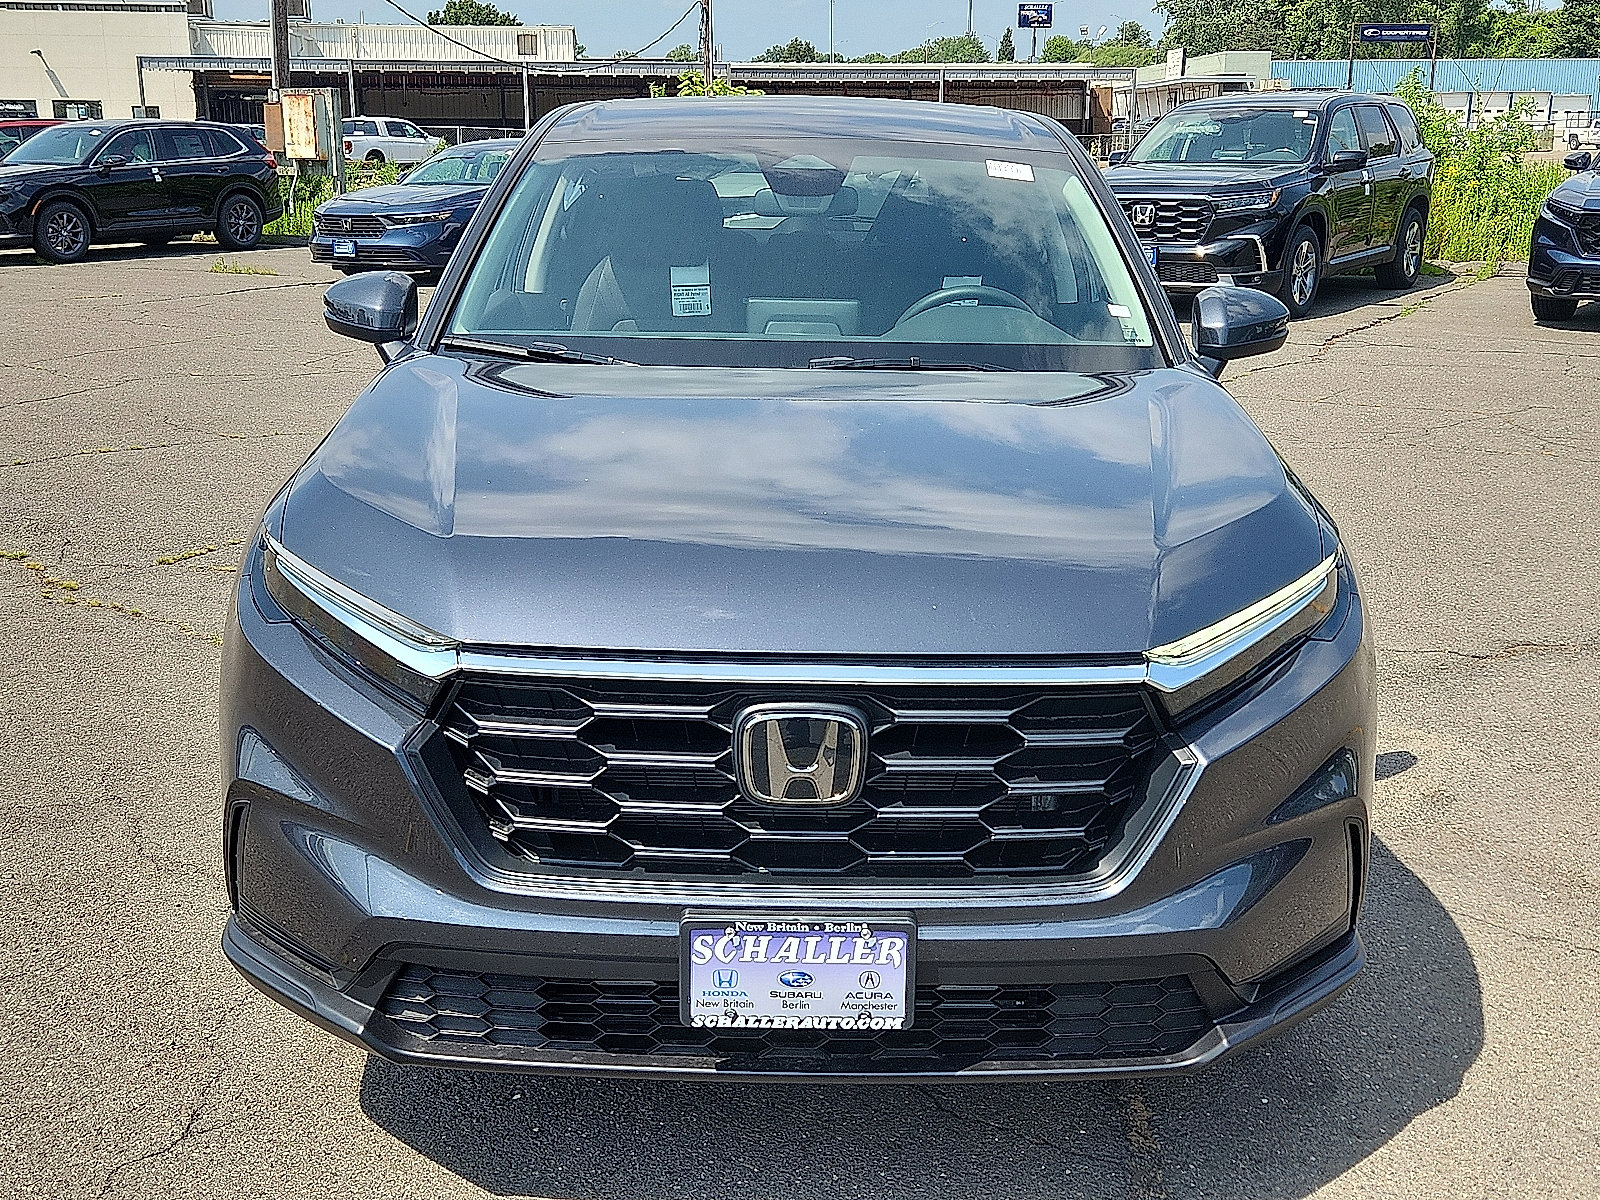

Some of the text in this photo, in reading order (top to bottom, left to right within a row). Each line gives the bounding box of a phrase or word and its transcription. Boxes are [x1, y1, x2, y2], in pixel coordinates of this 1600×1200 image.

[735, 922, 862, 933] New Britain Berlin
[692, 935, 905, 969] SCHALLER
[769, 991, 822, 999] SUBARU
[844, 991, 894, 1000] ACURA
[695, 999, 754, 1008] New Britain
[782, 1000, 810, 1010] Berlin
[840, 1001, 898, 1010] Manchester
[691, 1014, 905, 1030] SCHALLERAUTO.COM
